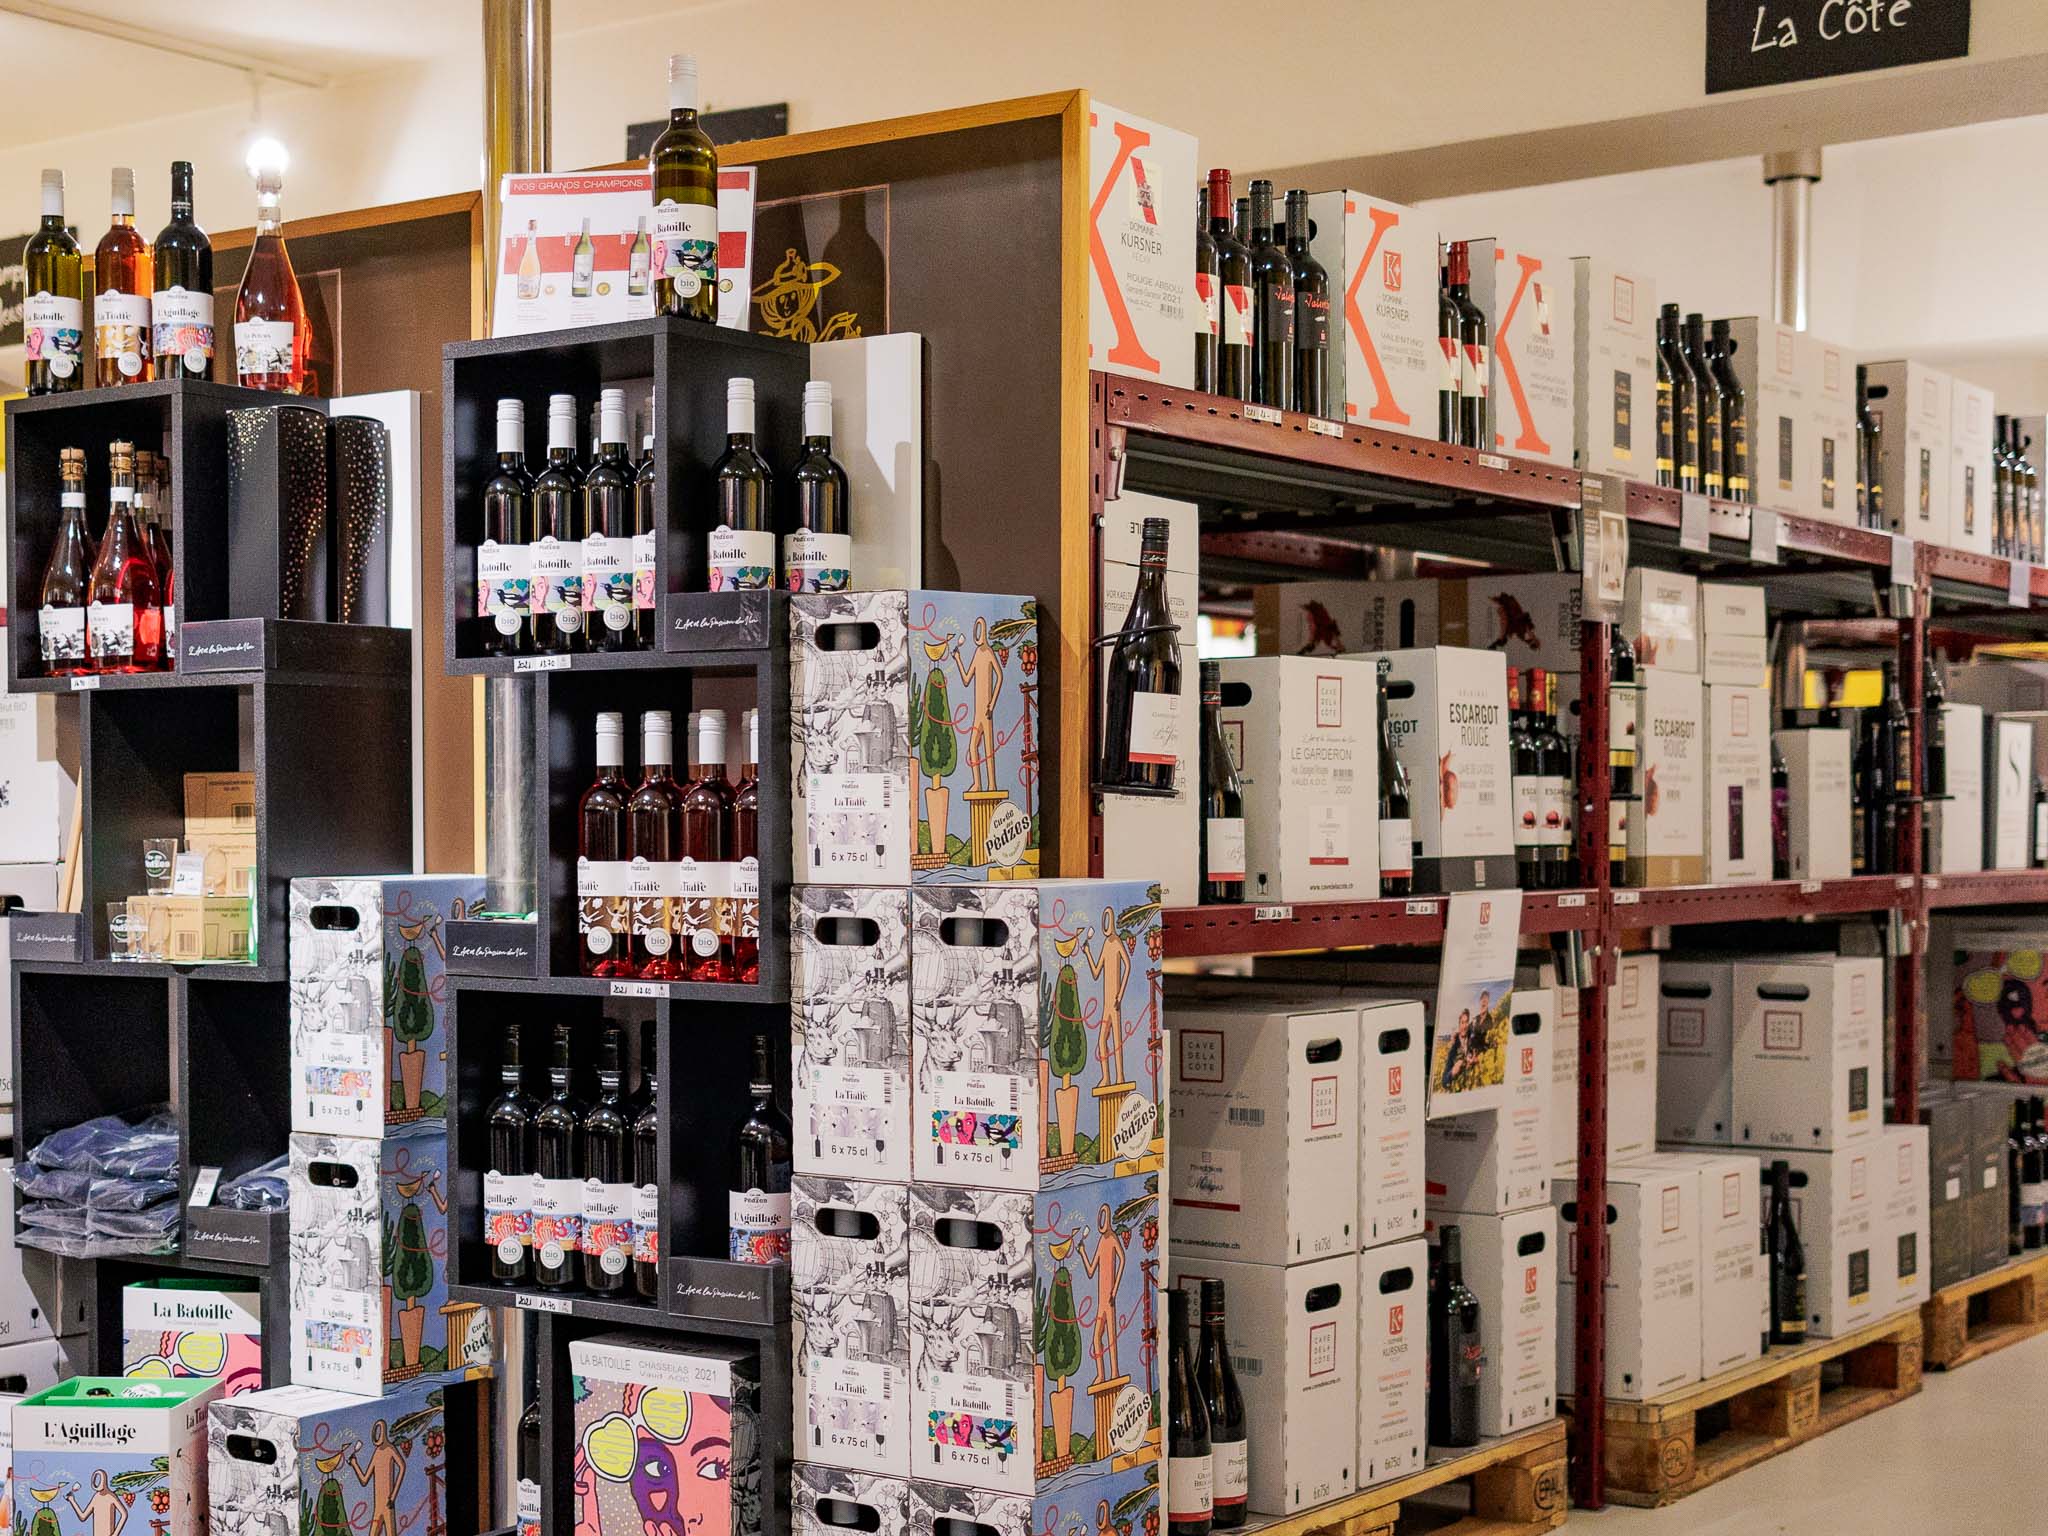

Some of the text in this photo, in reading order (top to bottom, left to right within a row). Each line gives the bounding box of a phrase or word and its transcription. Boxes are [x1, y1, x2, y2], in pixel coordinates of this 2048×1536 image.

[1751, 6, 1798, 52] La
[513, 179, 644, 193] NOS GRANDS CHAMPIONS
[656, 222, 693, 234] Batoille
[1121, 232, 1162, 256] KURSNER
[680, 278, 695, 289] bio
[1127, 272, 1153, 287] ROUGE
[1162, 291, 1181, 304] 2021
[33, 312, 65, 322] Batoille
[1376, 303, 1410, 322] KURSNER
[712, 549, 748, 560] Batoille
[792, 551, 828, 562] Batoille
[537, 558, 573, 570] Batoille
[587, 556, 620, 568] Batoille
[500, 616, 516, 628] bio
[562, 614, 577, 625] bio
[609, 611, 625, 622] bio
[1449, 703, 1499, 725] ESCARGOT
[1653, 718, 1696, 738] ESCARGOT
[1461, 726, 1490, 747] ROUGE
[1291, 747, 1352, 761] LE GARDERON
[834, 796, 844, 807] La
[831, 852, 837, 862] 6
[847, 852, 858, 862] 75
[860, 851, 868, 862] cl
[733, 880, 742, 892] La
[592, 935, 606, 945] bio
[650, 936, 666, 946] bio
[697, 938, 713, 947] bio
[1187, 1041, 1216, 1051] CAVE
[835, 1089, 843, 1100] La
[954, 1095, 996, 1107] La Batoille
[1169, 1108, 1184, 1119] 21
[831, 1144, 837, 1154] 6
[847, 1146, 859, 1156] 75
[860, 1147, 868, 1157] cl
[954, 1151, 960, 1160] 6
[971, 1152, 983, 1162] 75
[985, 1153, 993, 1163] cl
[734, 1211, 782, 1226] L'Aguillage
[503, 1245, 517, 1254] bio
[1169, 1237, 1241, 1251] ww.cavedelacote.ch
[545, 1250, 559, 1259] bio
[606, 1255, 621, 1265] bio
[153, 1302, 234, 1320] La Batoille
[580, 1354, 717, 1381] LA BATOILLE CHASSELAS 2021
[834, 1381, 844, 1392] La
[950, 1396, 992, 1412] La Batoille
[44, 1421, 137, 1445] L'Aguillage
[831, 1434, 837, 1443] 6
[847, 1436, 859, 1447] 75
[860, 1438, 868, 1449] cl
[951, 1450, 957, 1460] 6
[968, 1452, 979, 1464] 75
[981, 1454, 990, 1466] cl
